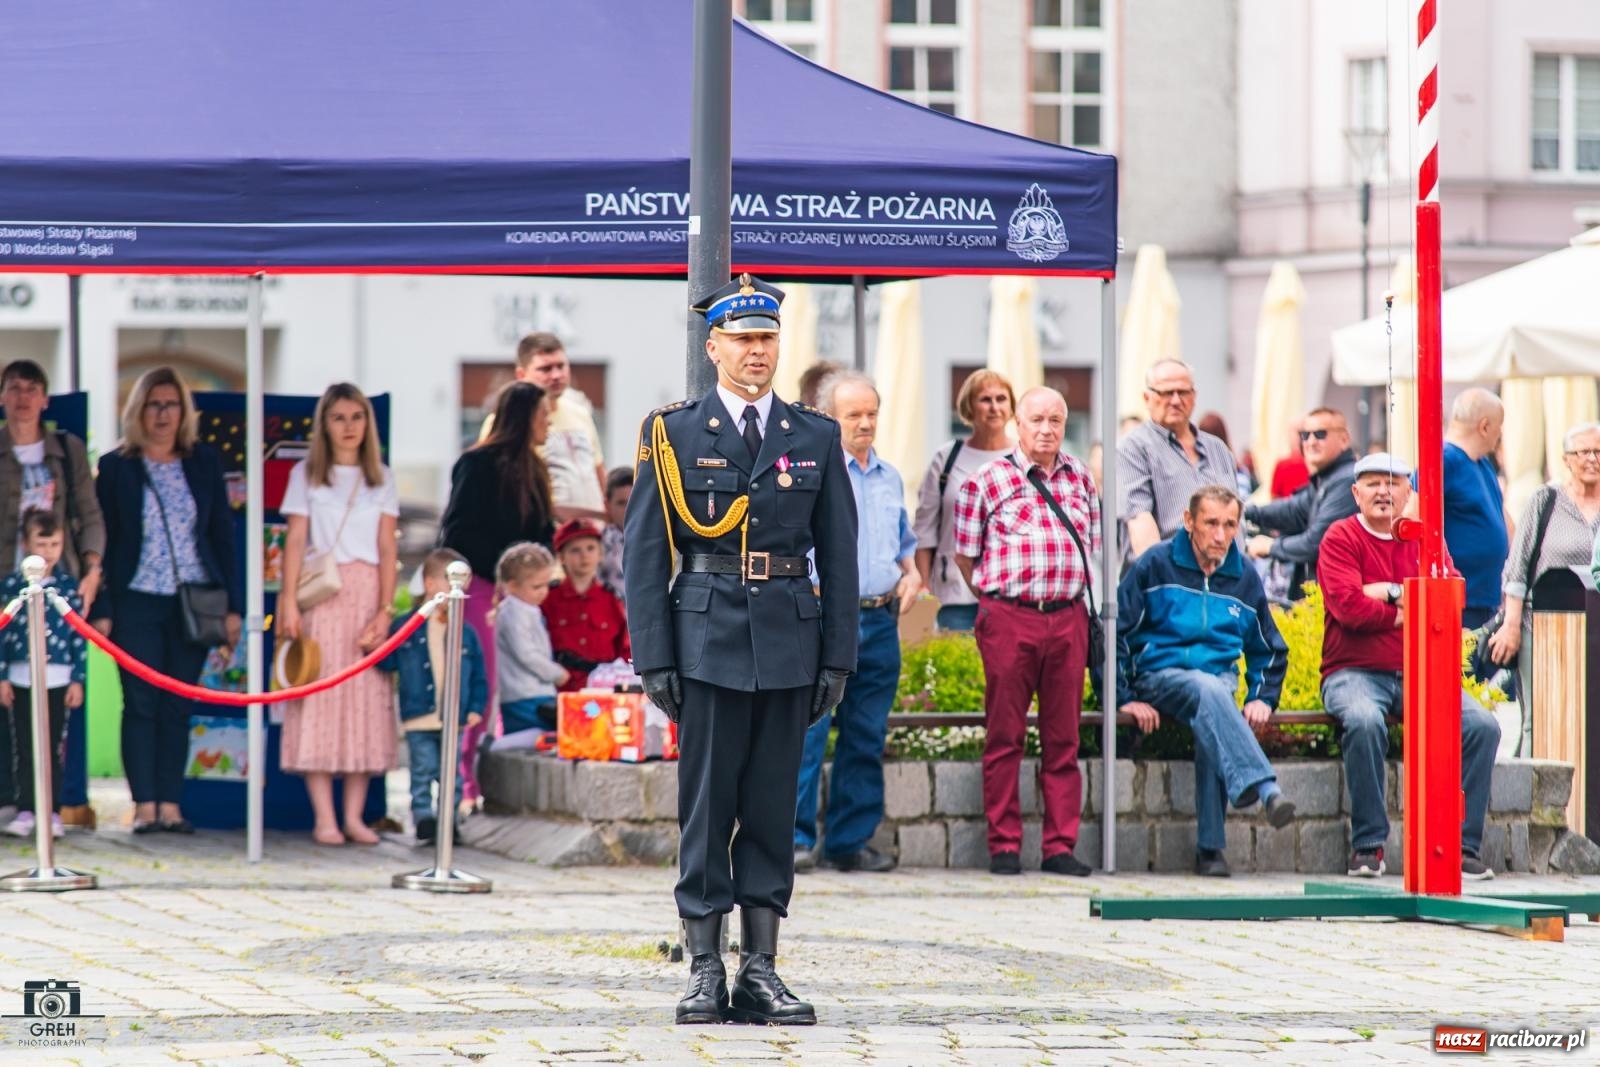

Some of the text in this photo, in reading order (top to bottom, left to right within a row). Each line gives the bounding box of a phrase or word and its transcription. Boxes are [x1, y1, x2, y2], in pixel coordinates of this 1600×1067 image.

[585, 186, 996, 220] PAŃSTWWA STRAŻ POŻARNA
[46, 226, 83, 241] Straży
[85, 227, 137, 241] Pożarnej
[505, 231, 569, 244] KOMENDA
[571, 230, 647, 243] POWIATOWA
[733, 230, 777, 243] STRAŻY
[780, 231, 841, 247] POŻARNEJ
[843, 234, 856, 246] W
[858, 234, 944, 246] WODZISŁAWIU
[947, 234, 997, 249] ŚLĄSKIM
[14, 242, 77, 256] Wodzisław
[78, 241, 114, 258] Śląski
